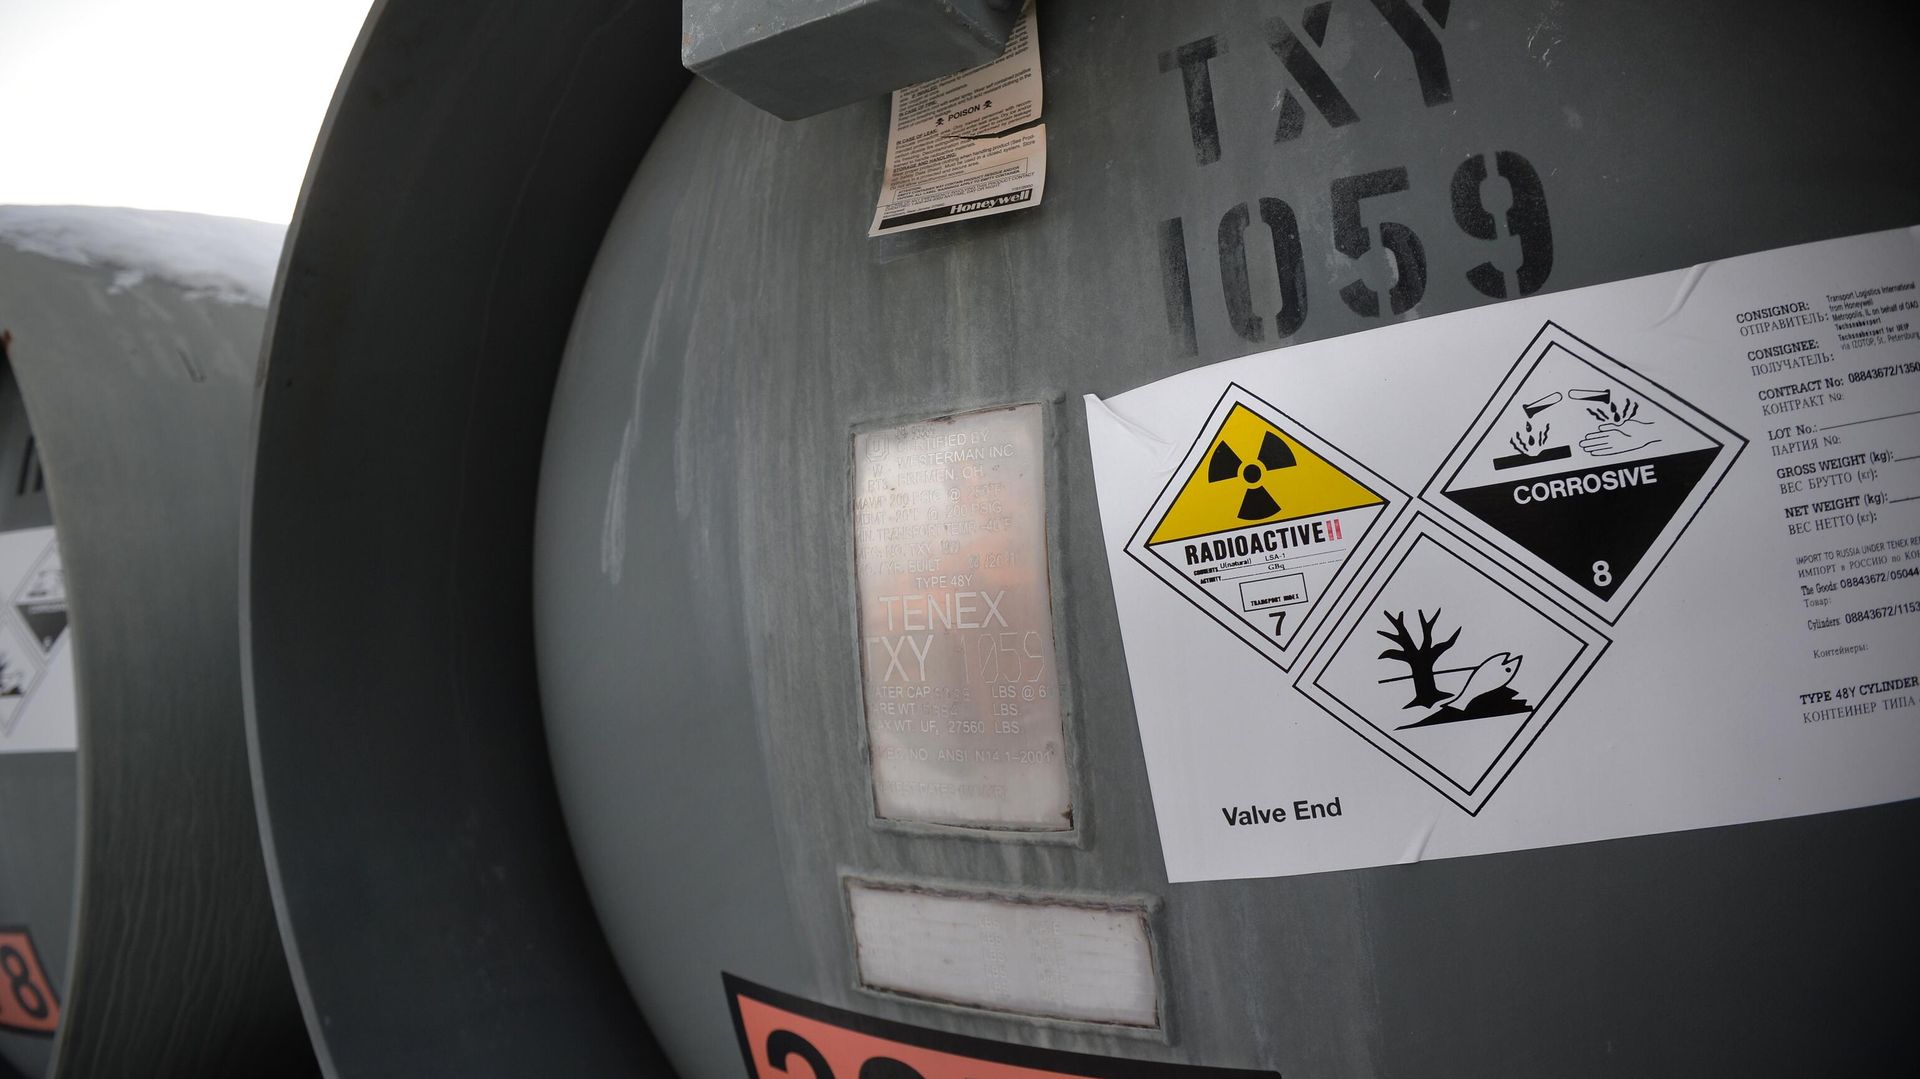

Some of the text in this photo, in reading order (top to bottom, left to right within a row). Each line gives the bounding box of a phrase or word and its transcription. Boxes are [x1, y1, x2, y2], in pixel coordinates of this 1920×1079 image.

[1157, 0, 1453, 167] TXY
[947, 104, 981, 121] POISON
[949, 190, 1030, 215] Honeywell
[1157, 150, 1554, 356] 1059
[1736, 281, 1916, 323] CONSIGNOR: Transport Logistics International
[1829, 298, 1873, 312] from Honeywell
[1740, 312, 1829, 336] ОТПРАВИТЕЛЬ:
[1747, 339, 1819, 361] CONSIGNEE:
[1751, 353, 1835, 376] ПОЛУЧАТЕЛЬ:
[1758, 380, 1822, 401] CONTRACT
[1824, 377, 1844, 389] No:
[1762, 395, 1824, 416] КОНТРАКТ
[1768, 427, 1792, 441] LOT
[1771, 439, 1819, 456] ПАРТИЯ
[1776, 450, 1894, 479] GROSS WEIGHT (kg):
[1513, 464, 1657, 504] CORROSIVE
[1780, 480, 1803, 495] ВЕС
[1809, 472, 1853, 490] БРУТТО
[1784, 492, 1889, 518] NET WEIGHT (kg):
[1788, 522, 1812, 535] ВЕС
[1815, 514, 1854, 531] НЕТТО
[1184, 521, 1326, 565] RADIOACTIVE
[1796, 552, 1822, 565] IMPORT
[1824, 550, 1834, 560] TO
[1836, 547, 1860, 559] RUSSIA
[1861, 542, 1885, 554] UNDER
[1887, 538, 1909, 550] TENEX
[1268, 563, 1286, 571] GBq
[1592, 560, 1612, 586] 8
[1798, 564, 1837, 578] ИМПОРТ
[1849, 555, 1888, 570] РОССИЮ
[1891, 555, 1901, 563] по
[916, 574, 973, 589] TYPE 48Y
[1801, 584, 1815, 596] The
[878, 590, 1008, 631] TENEX
[1269, 611, 1286, 636] 7
[1813, 643, 1869, 659] Контейнеры:
[1800, 676, 1919, 705] TYPE 48Y CYLINDER
[1882, 696, 1916, 711] ТИПА
[949, 720, 985, 734] 27560
[1222, 797, 1342, 826] Valve End
